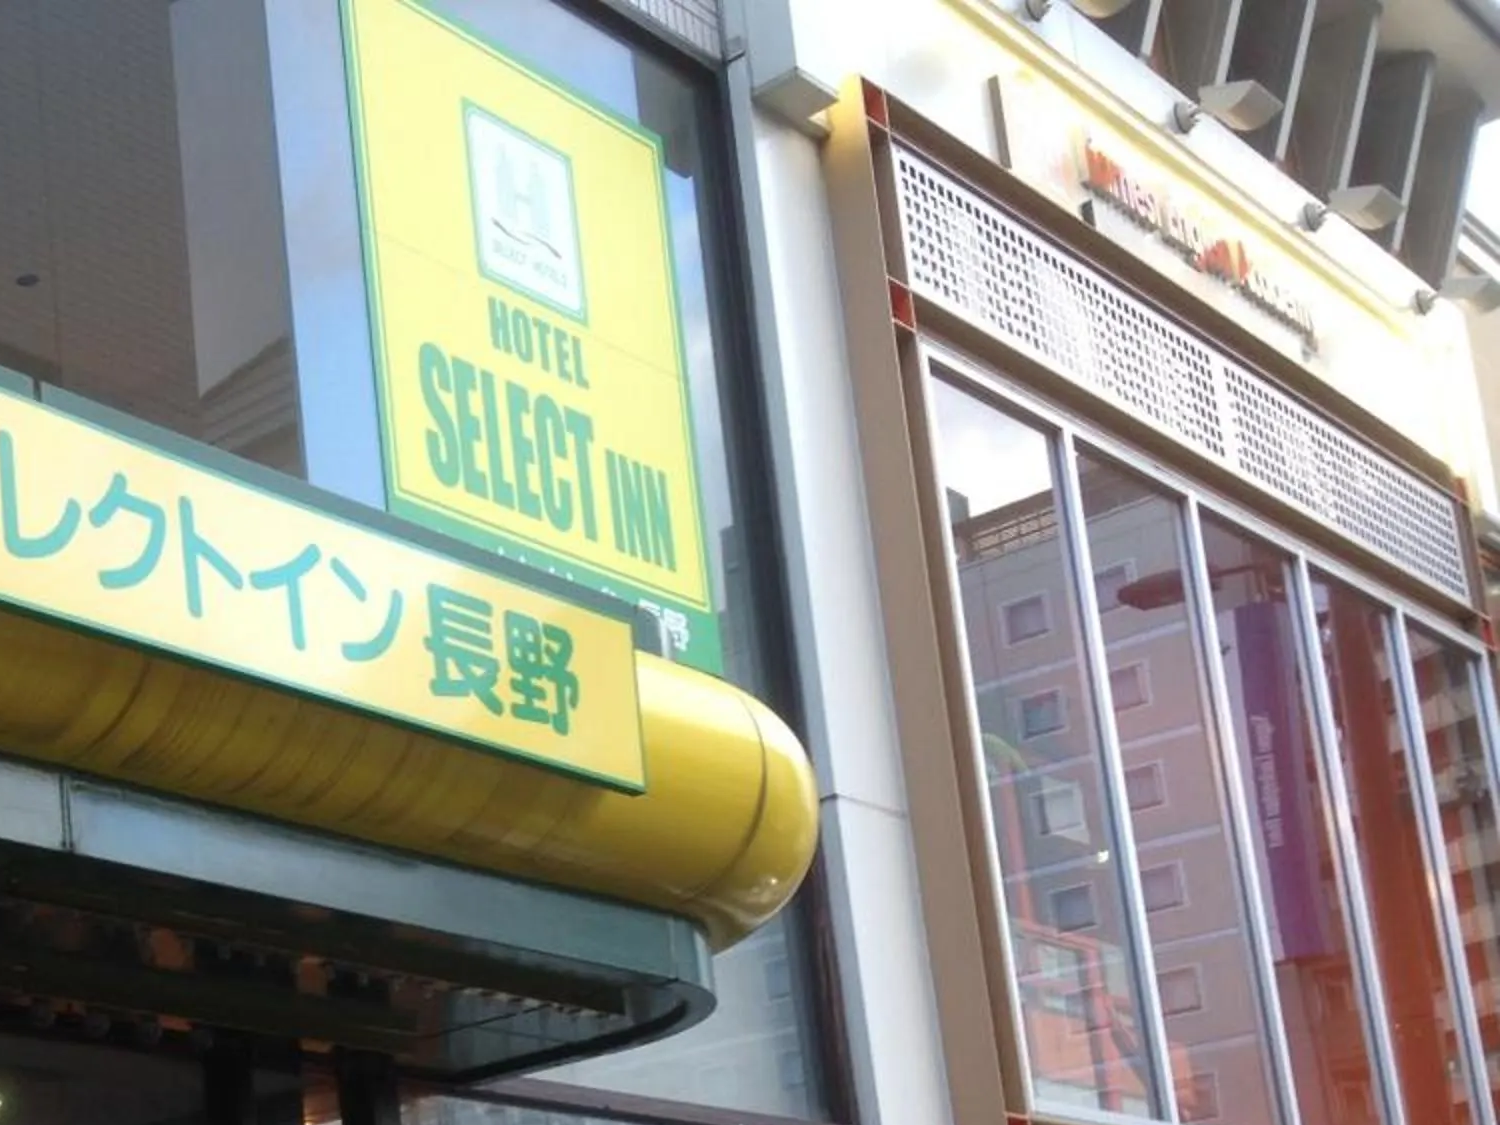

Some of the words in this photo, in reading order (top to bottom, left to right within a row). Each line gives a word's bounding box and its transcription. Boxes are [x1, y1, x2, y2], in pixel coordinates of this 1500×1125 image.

[488, 296, 590, 390] HOTEL
[418, 341, 598, 544] SELECT
[604, 449, 678, 573] INN
